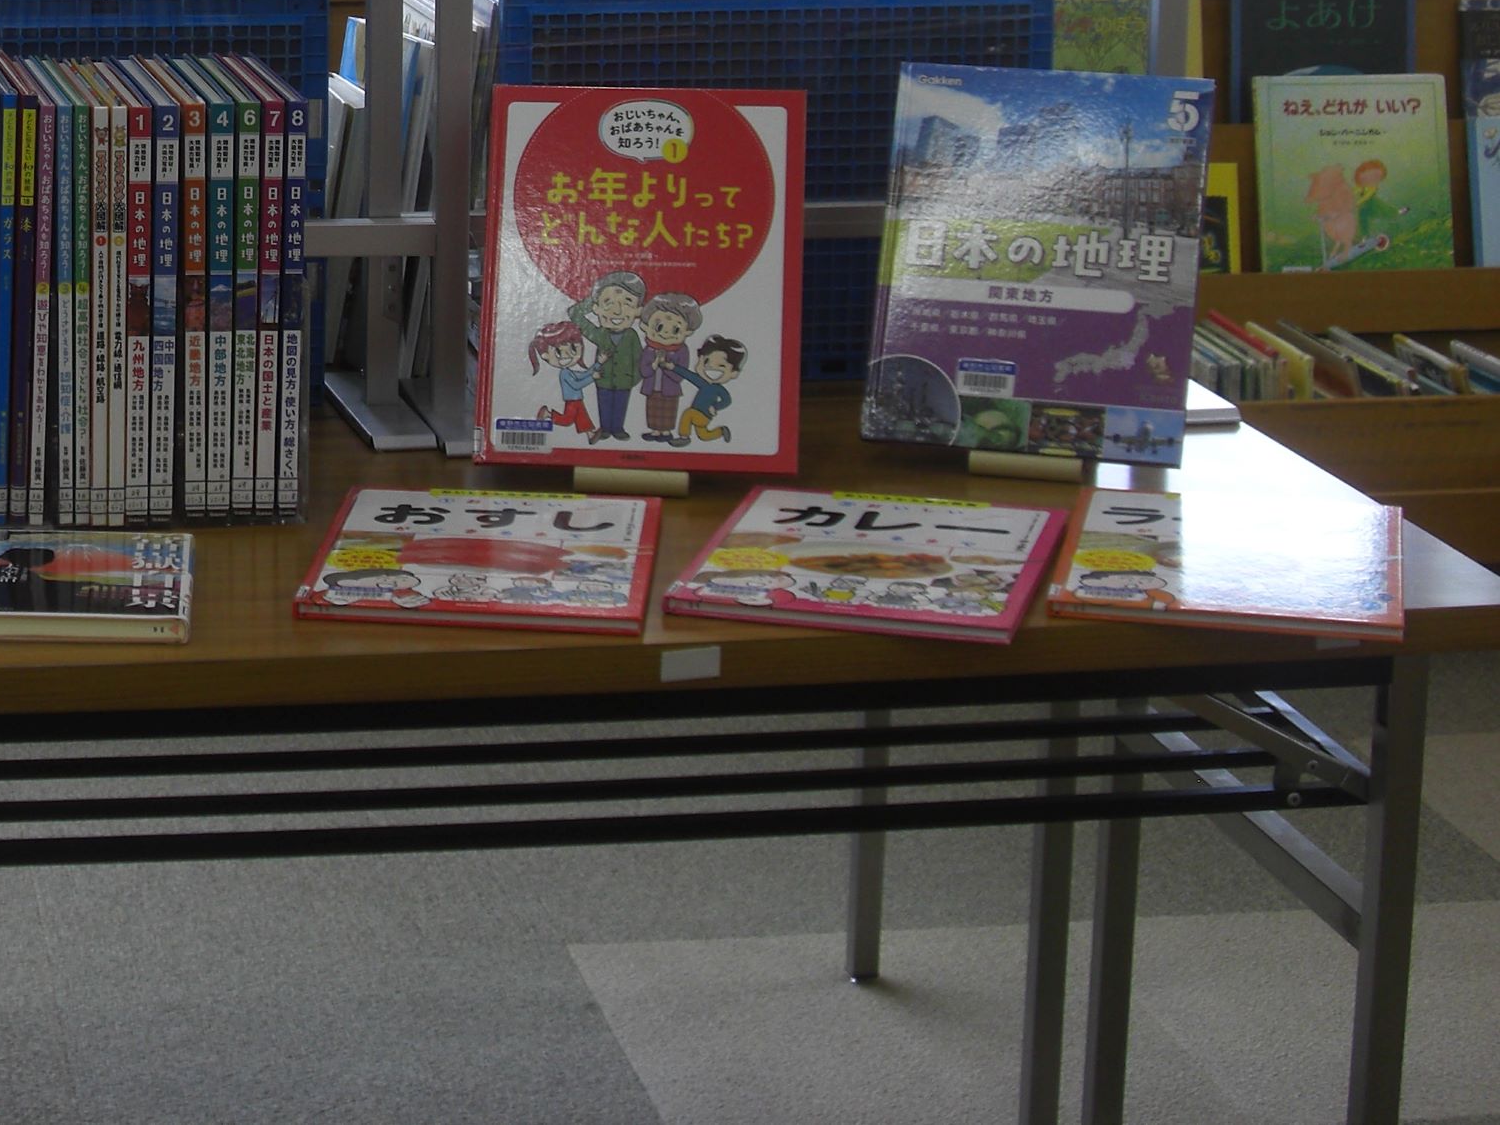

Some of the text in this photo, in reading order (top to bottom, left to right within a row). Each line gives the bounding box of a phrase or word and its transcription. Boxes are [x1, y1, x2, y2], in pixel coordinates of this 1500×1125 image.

[918, 74, 962, 86] Gakken
[135, 114, 144, 131] 1
[162, 115, 174, 131] 2
[189, 111, 201, 127] 3
[216, 110, 229, 127] 4
[243, 109, 256, 125] 6
[269, 110, 281, 127] 7
[291, 109, 303, 126] 8
[1166, 91, 1200, 132] 5
[546, 168, 742, 208] お年よりって
[133, 191, 147, 267] 日本の地理
[160, 191, 173, 267] 日本の地理
[189, 187, 202, 263] 日本の地理
[215, 187, 229, 263] 日本の地理
[241, 186, 255, 262] 日本の地理
[265, 186, 278, 262] 日本の地理
[288, 186, 302, 262] 日本の地理
[540, 211, 753, 249] どんな人たち？
[905, 220, 1174, 283] 日本の地理
[132, 339, 146, 392] 九州地方
[214, 334, 227, 387] 中部地方
[261, 334, 274, 432] 日本の国土と産業
[374, 504, 614, 531] おすし
[773, 505, 1011, 534] カレー
